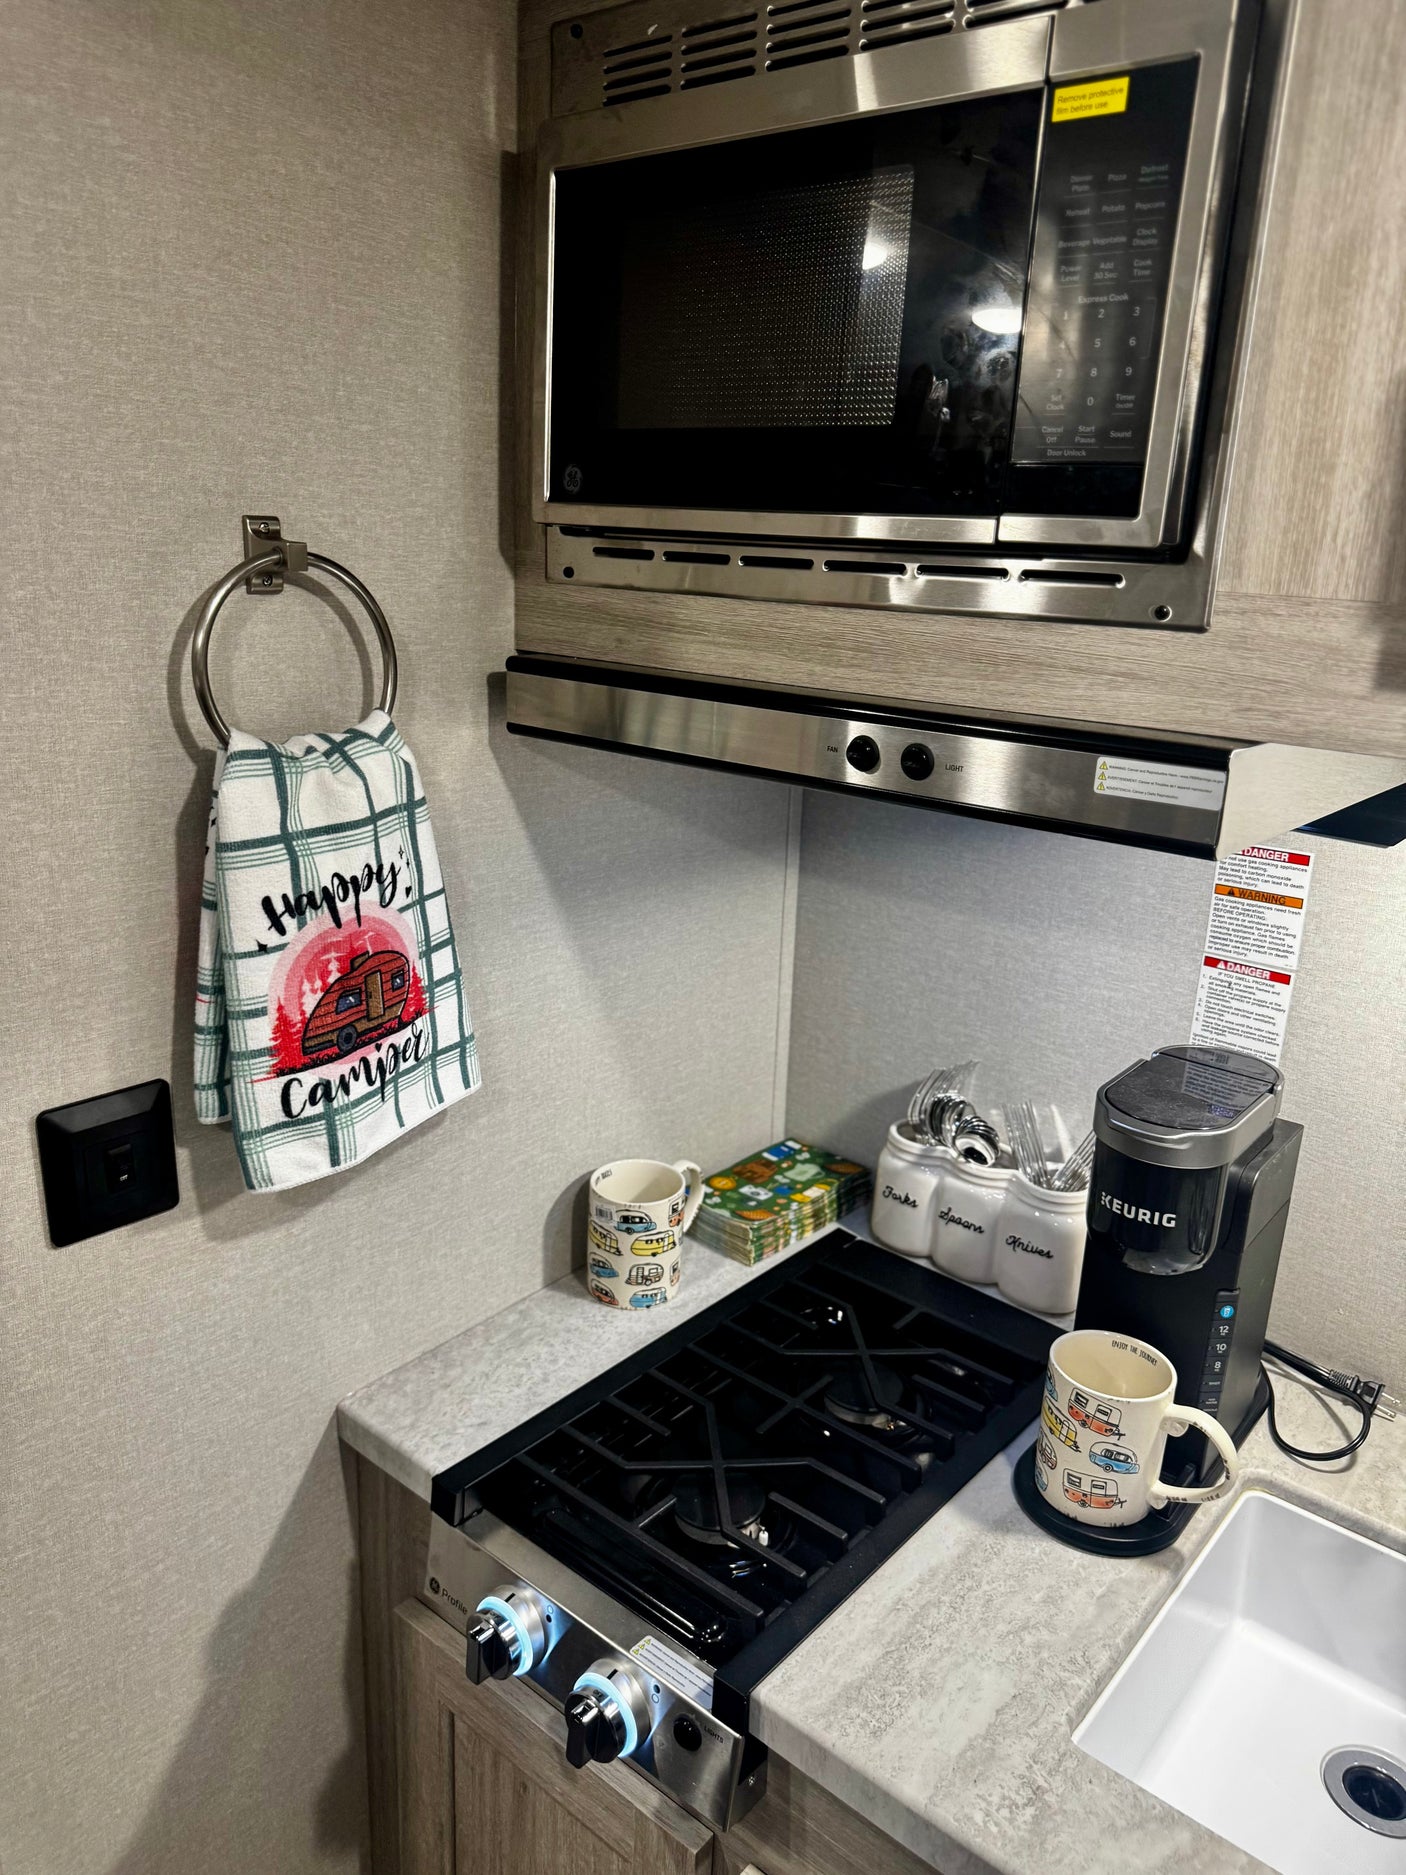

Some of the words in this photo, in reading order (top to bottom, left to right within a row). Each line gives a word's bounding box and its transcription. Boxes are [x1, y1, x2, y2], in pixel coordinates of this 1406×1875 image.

[1057, 93, 1086, 104] Remove
[1088, 87, 1124, 100] protective
[1070, 103, 1093, 113] before
[1109, 293, 1129, 302] Cook
[1110, 430, 1132, 438] Sound
[826, 745, 839, 753] FAN
[944, 763, 964, 773] LIGHT
[1244, 848, 1289, 862] DANGER
[261, 861, 401, 936] Happy
[1238, 889, 1286, 905] WARNING
[1226, 962, 1271, 980] DANGER
[281, 1022, 430, 1119] Camper
[882, 1185, 919, 1208] Forks
[1100, 1191, 1177, 1228] KEURIG
[938, 1207, 984, 1235] Spoons
[1006, 1234, 1054, 1259] Knives
[1219, 1325, 1229, 1333] 12
[1112, 1339, 1128, 1350] ENJOY
[1130, 1344, 1138, 1355] THE
[1216, 1343, 1227, 1351] 10
[441, 1588, 468, 1615] Profile
